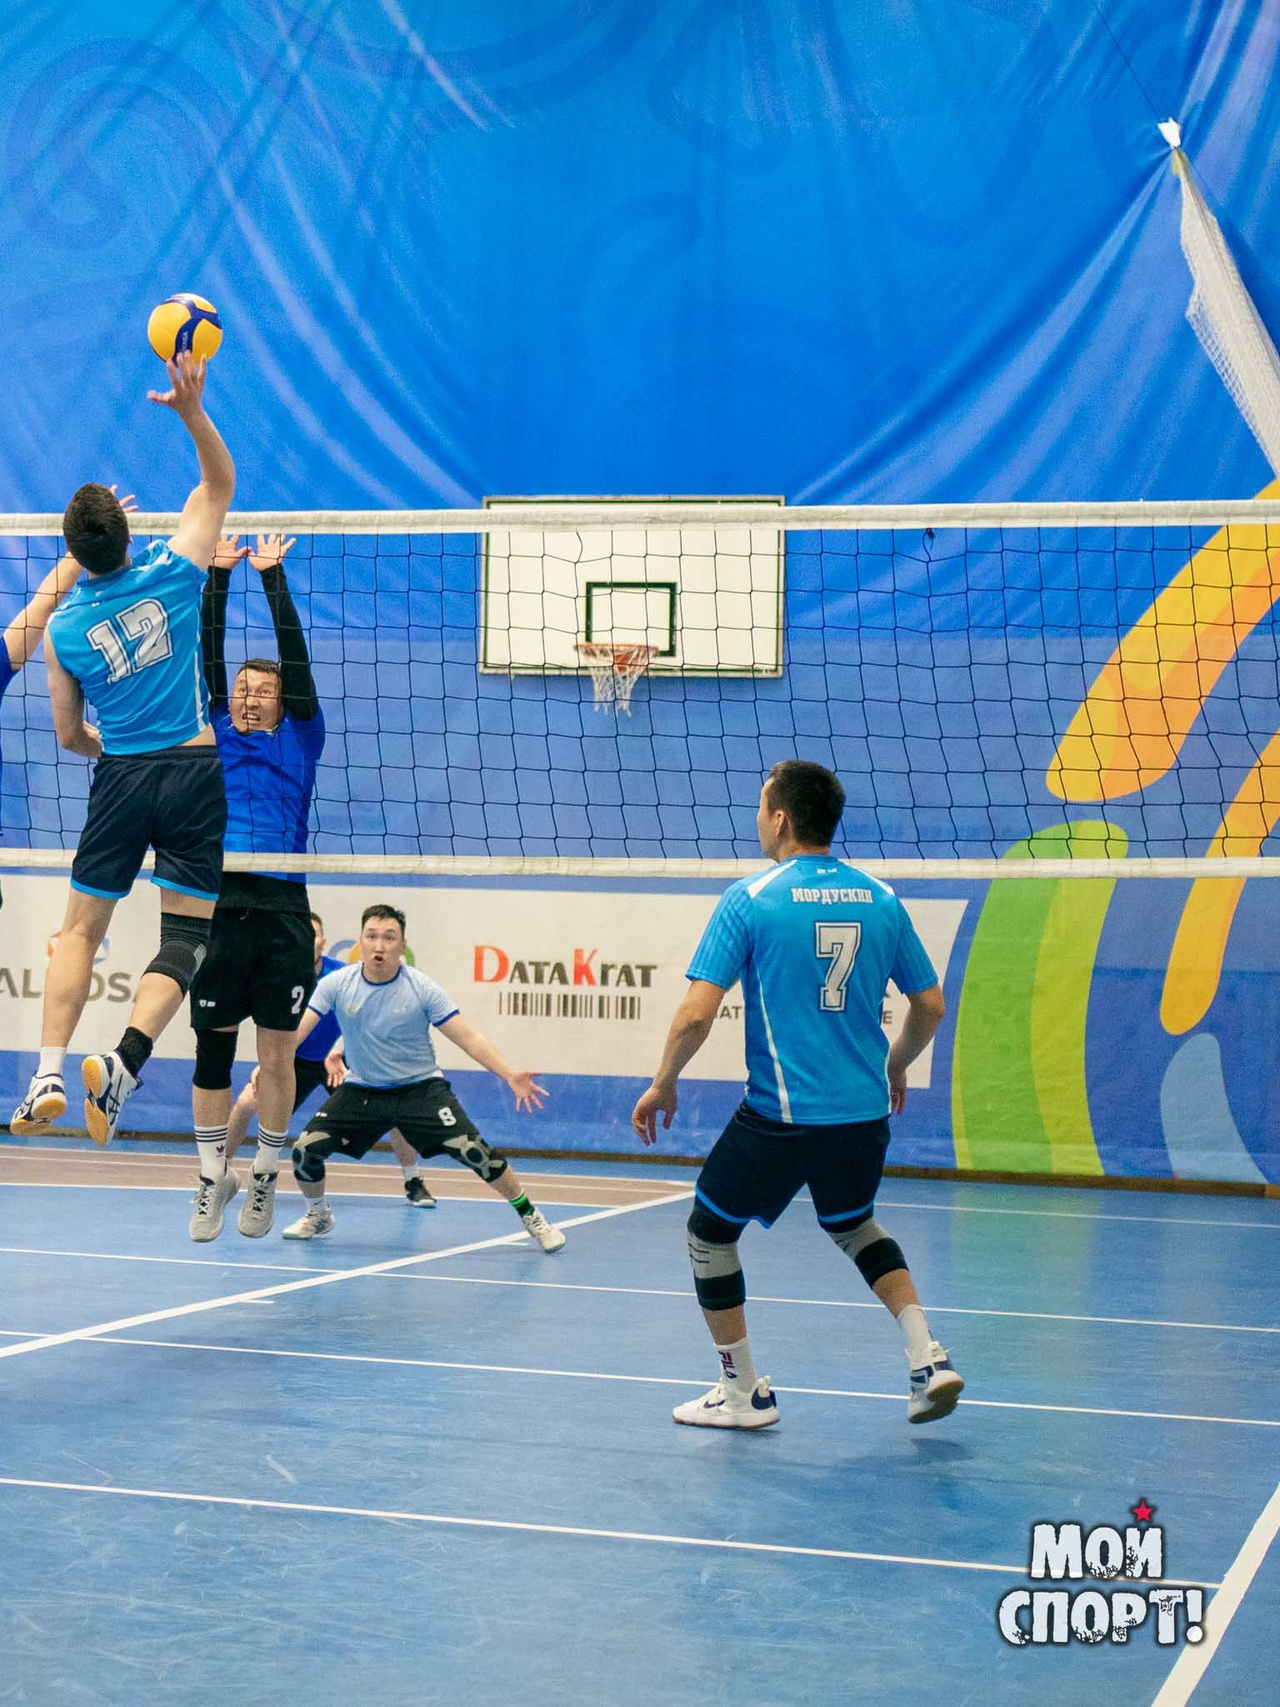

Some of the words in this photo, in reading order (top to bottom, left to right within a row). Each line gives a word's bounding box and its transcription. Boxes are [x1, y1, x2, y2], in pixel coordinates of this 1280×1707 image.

[86, 598, 174, 684] 12
[815, 922, 862, 1012] 7
[291, 985, 305, 1014] 2
[438, 1107, 457, 1126] 8
